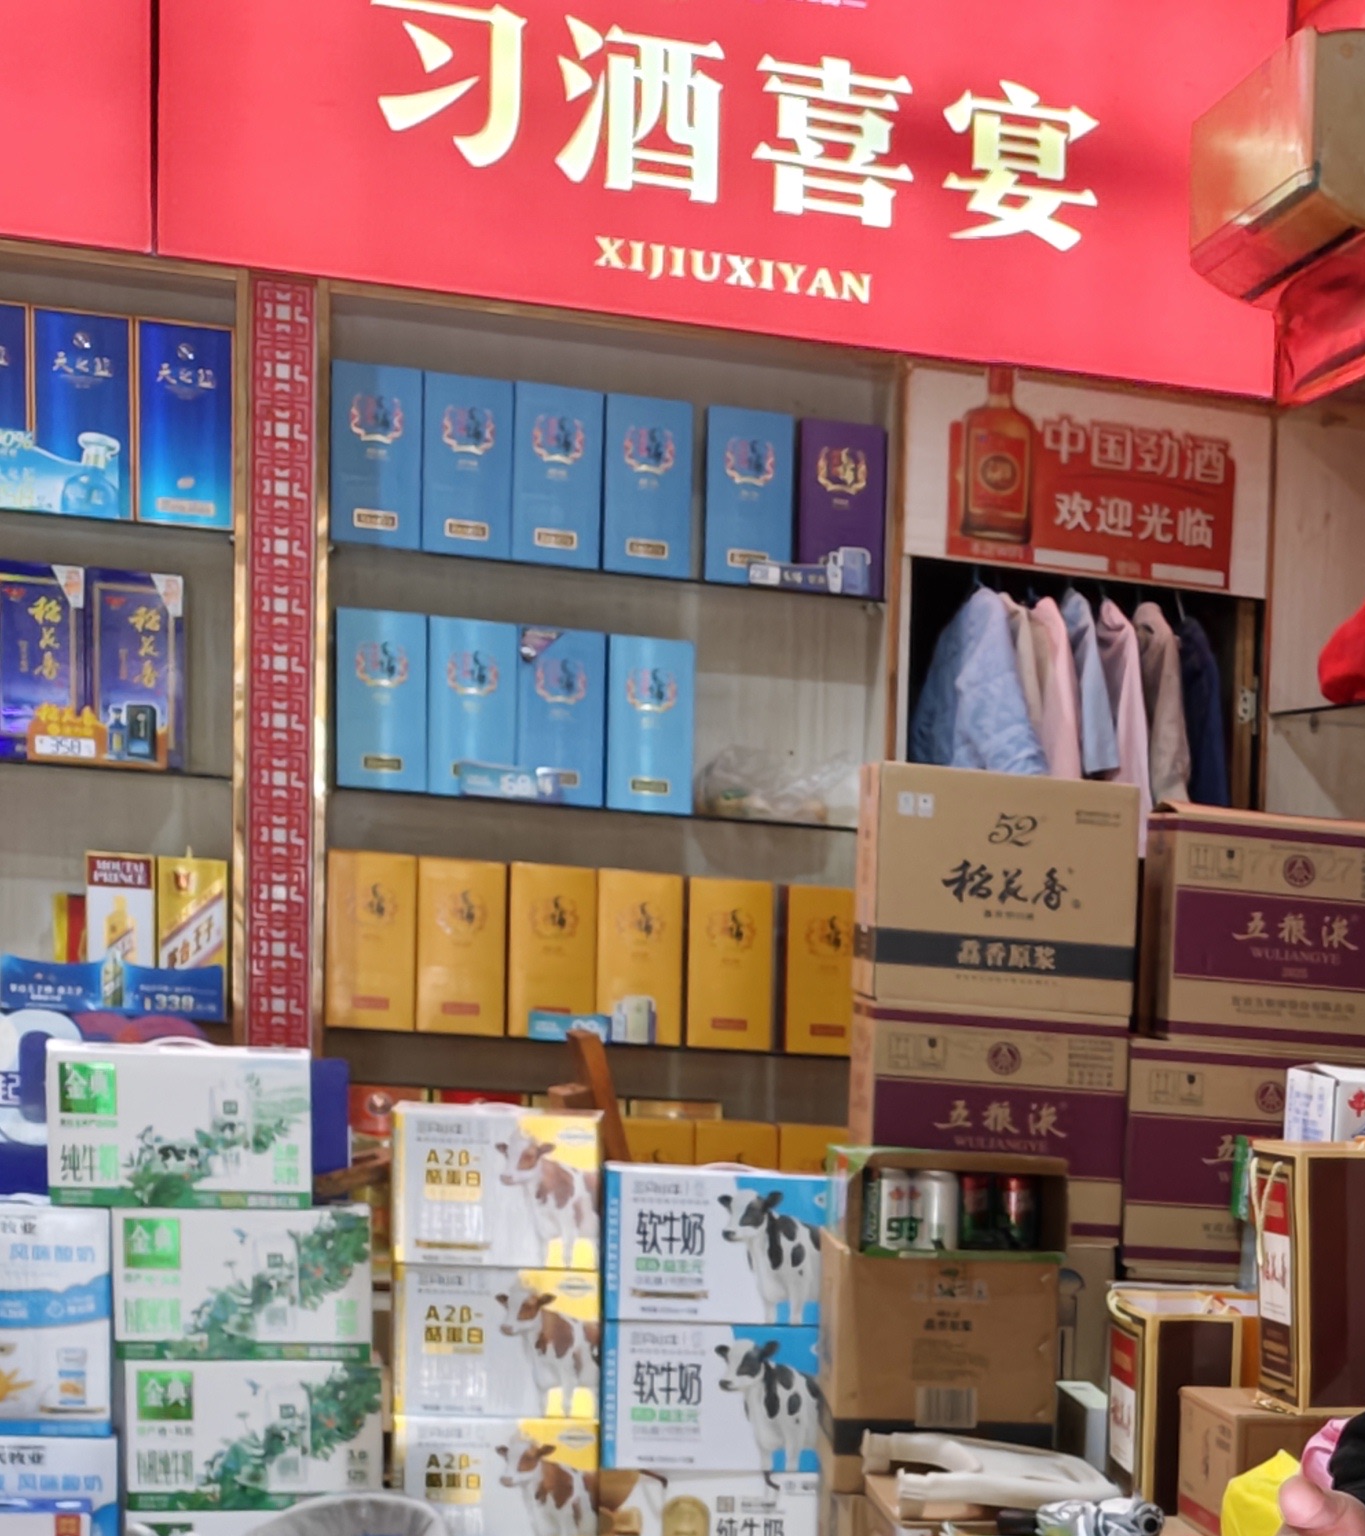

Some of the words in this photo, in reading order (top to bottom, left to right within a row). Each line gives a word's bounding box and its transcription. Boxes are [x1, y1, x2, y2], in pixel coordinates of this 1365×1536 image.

[371, 0, 1099, 251] 习酒喜宴
[595, 236, 871, 304] XIJIUXIYAN
[1043, 417, 1226, 484] 中国劲酒
[1054, 492, 1214, 549] 欢迎光临
[988, 812, 1037, 847] 52
[941, 860, 1068, 911] 稻花香
[1232, 911, 1359, 950] 五粮液
[1251, 947, 1342, 966] WULIANGYE
[934, 1100, 1067, 1138] 五粮液
[636, 1210, 705, 1256] 软牛奶
[633, 1360, 702, 1406] 软牛奶
